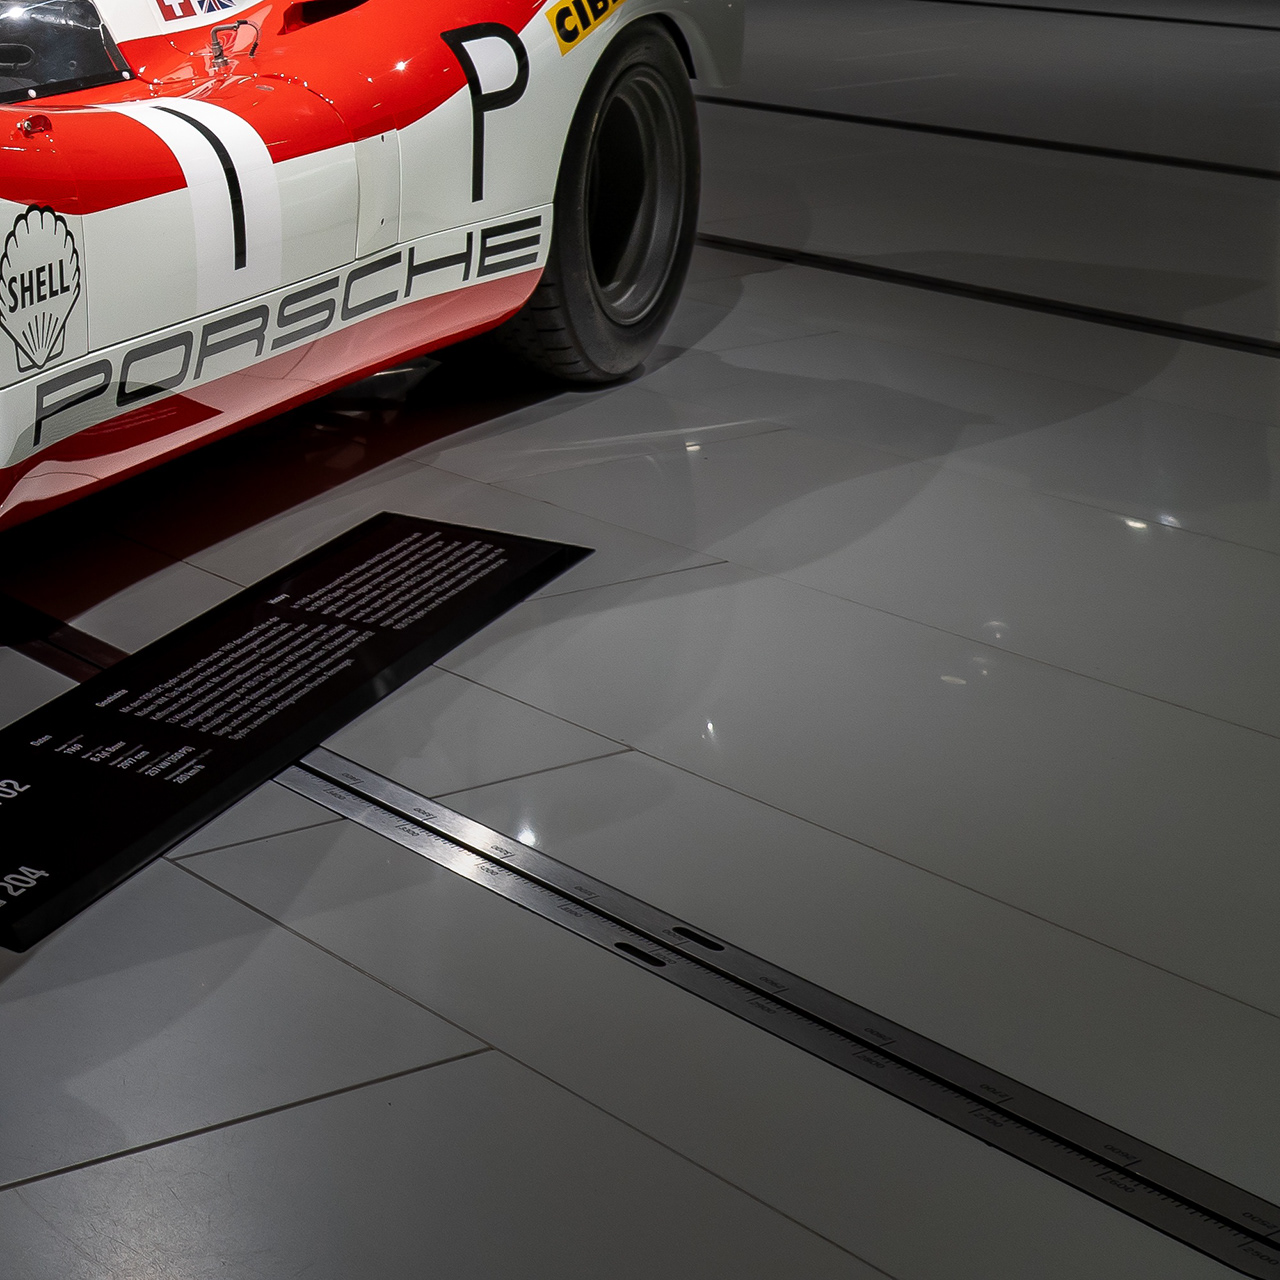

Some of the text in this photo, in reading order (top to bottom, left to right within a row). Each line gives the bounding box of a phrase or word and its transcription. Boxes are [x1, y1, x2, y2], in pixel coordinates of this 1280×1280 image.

[440, 22, 529, 203] P
[7, 253, 71, 314] SHELL
[33, 214, 542, 447] PORSCHE
[974, 1112, 1003, 1128] 2700
[1103, 1176, 1136, 1194] 2600
